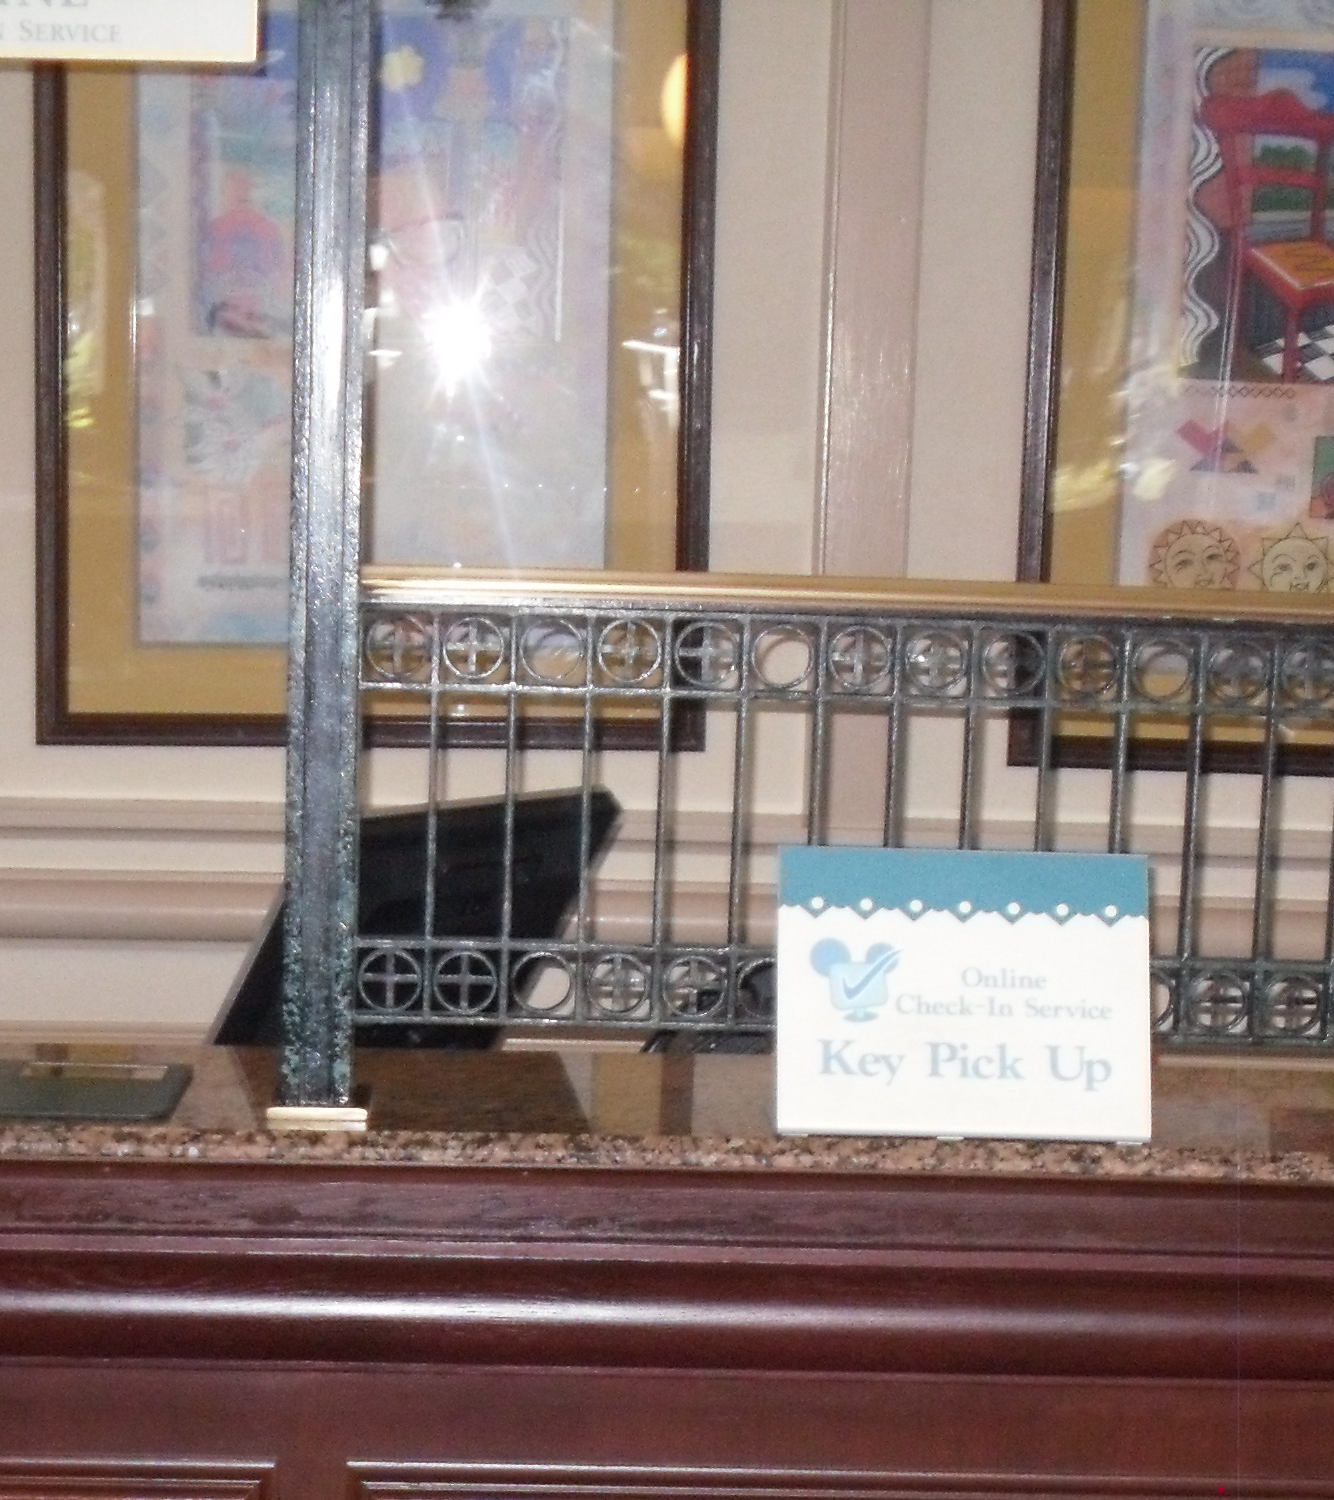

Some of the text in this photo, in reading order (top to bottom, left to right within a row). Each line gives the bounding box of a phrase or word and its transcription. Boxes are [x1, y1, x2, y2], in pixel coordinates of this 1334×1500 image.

[18, 19, 123, 44] SERVICE
[960, 966, 1047, 990] Online
[895, 993, 1113, 1021] Check-In Service
[816, 1038, 1113, 1092] Key Pick Up
